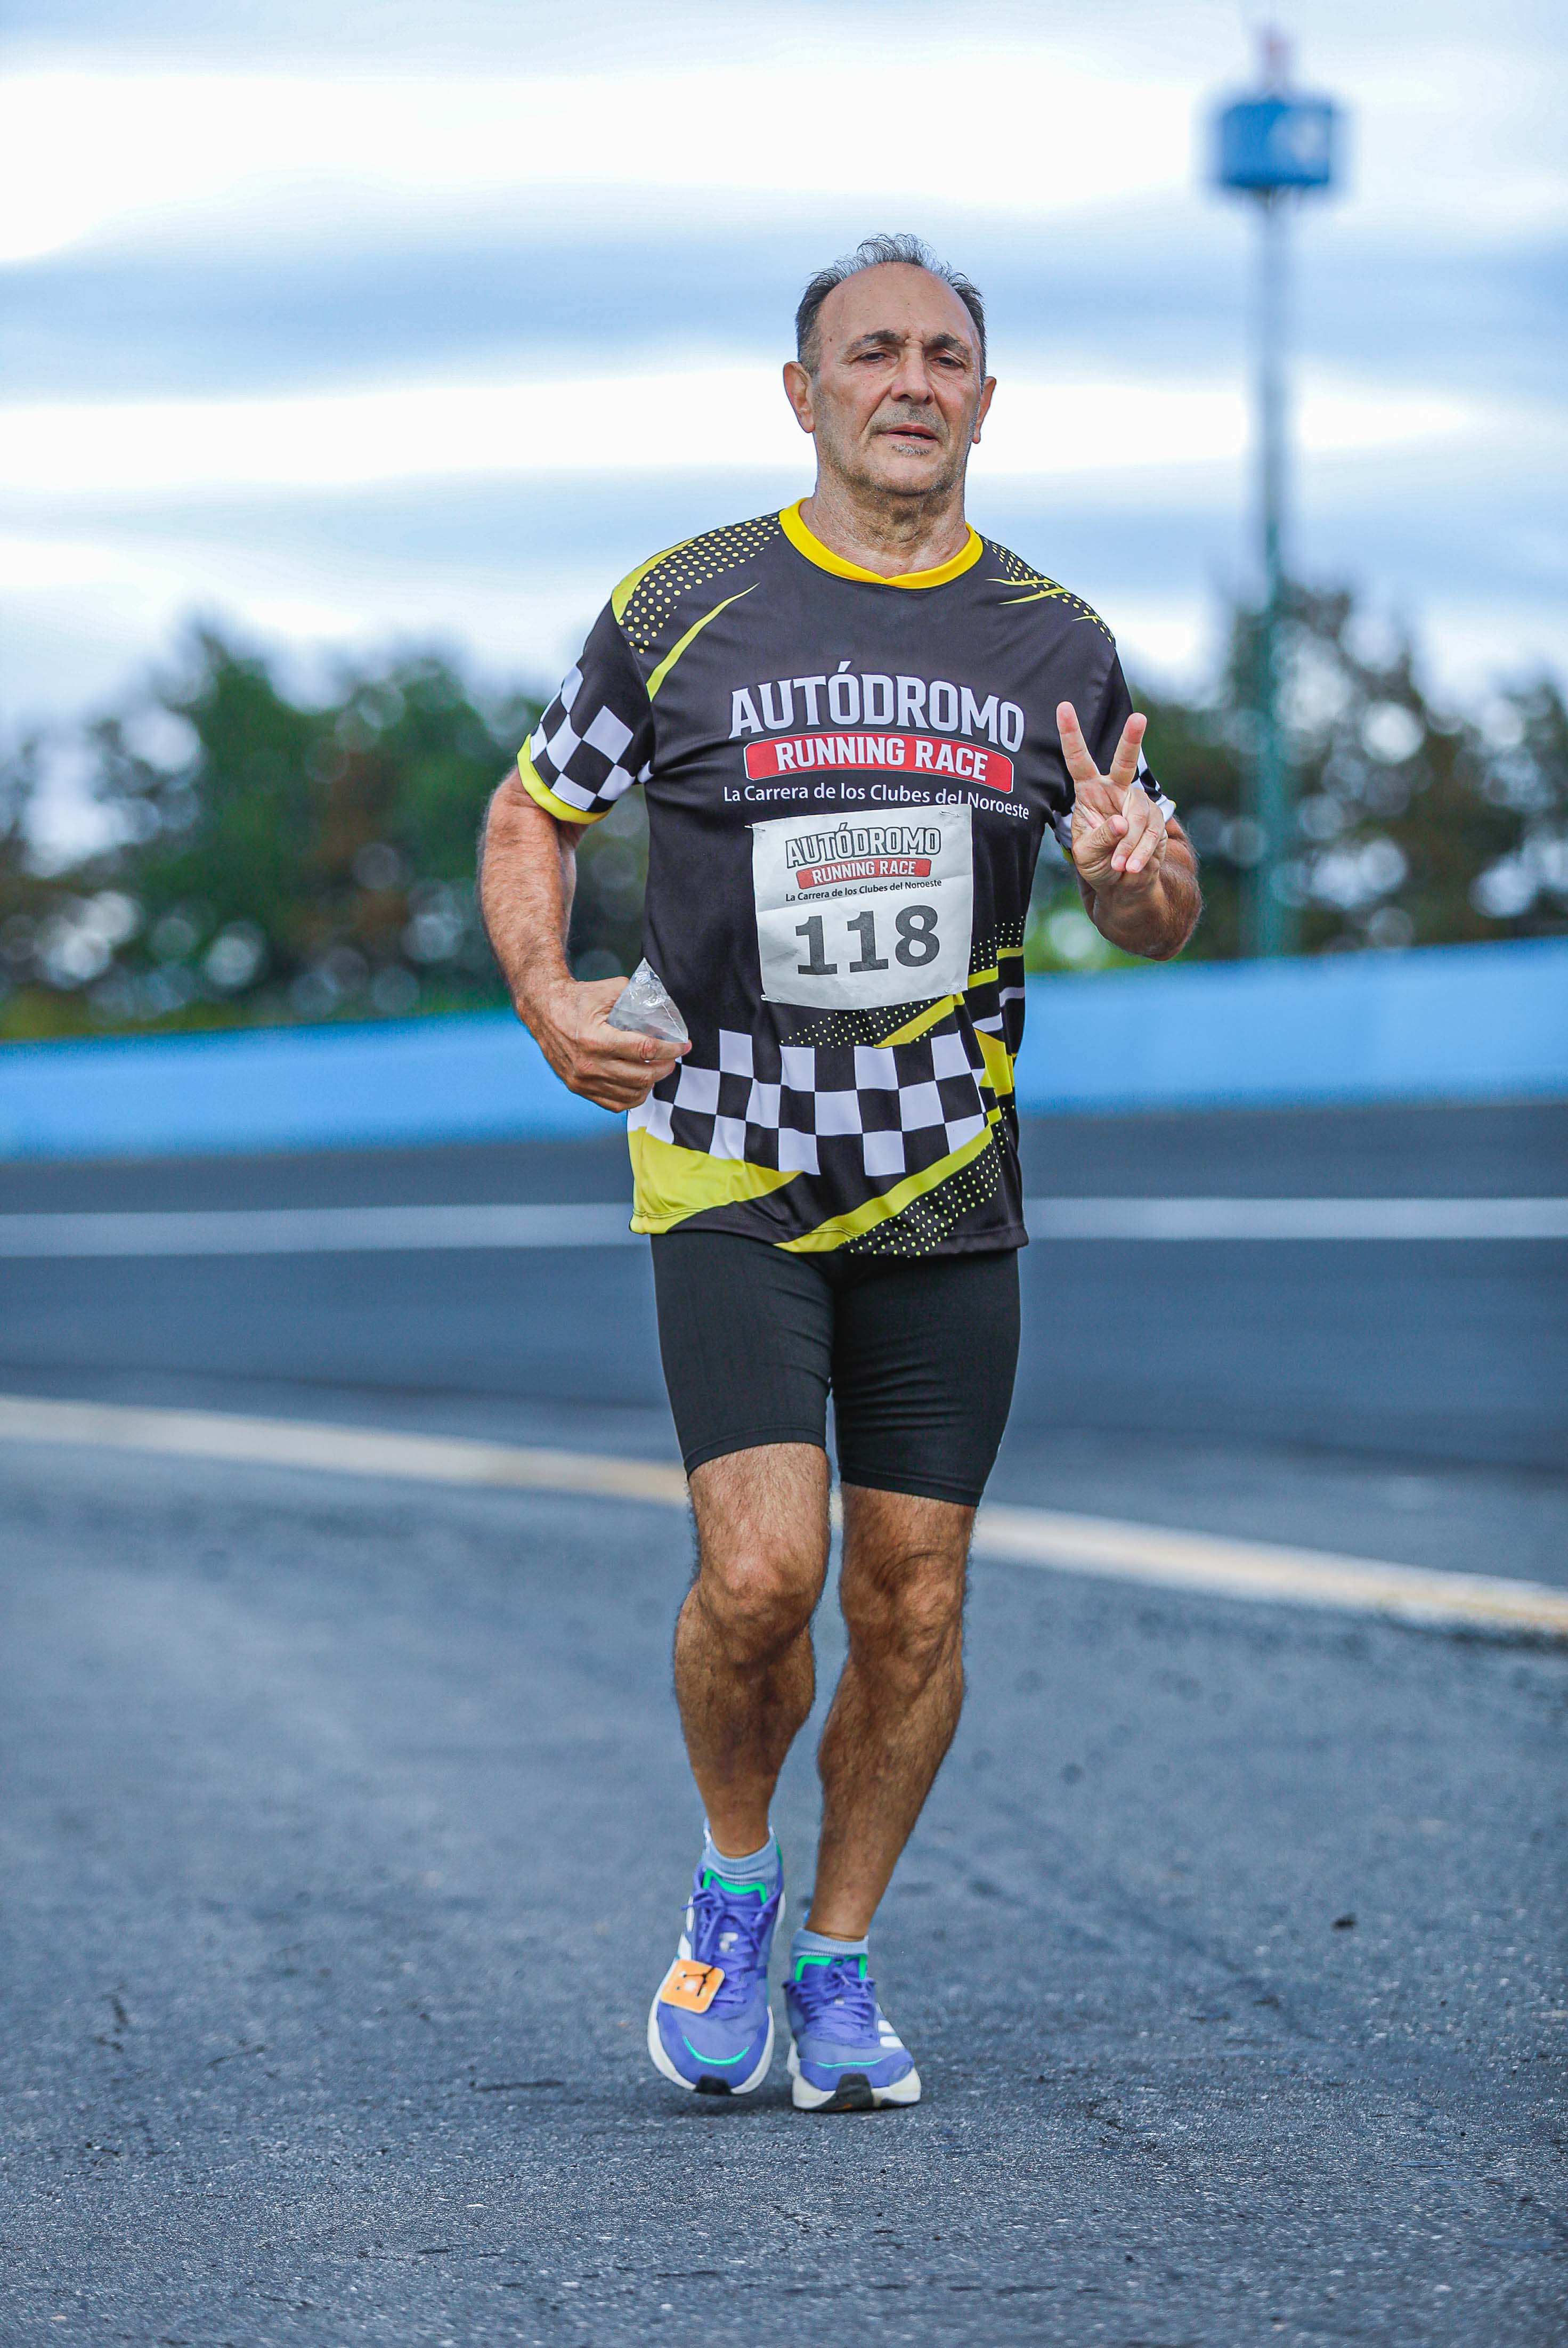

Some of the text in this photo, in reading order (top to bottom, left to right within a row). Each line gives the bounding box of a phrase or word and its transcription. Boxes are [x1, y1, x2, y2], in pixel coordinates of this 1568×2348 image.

[728, 660, 1025, 752] AUTÓDROMO
[774, 736, 988, 782] RUNNING RACE
[724, 782, 1029, 820] La Carrera de los Clubes del Noroeste
[785, 822, 941, 868] AUTÓDROMO
[786, 893, 795, 901] La
[798, 891, 830, 901] Carrera
[832, 888, 843, 897] de
[845, 887, 857, 896] los
[859, 884, 888, 895] Clubes
[905, 879, 942, 890] Noroeste
[812, 860, 916, 884] RUNNING RACE
[795, 905, 940, 976] 118
